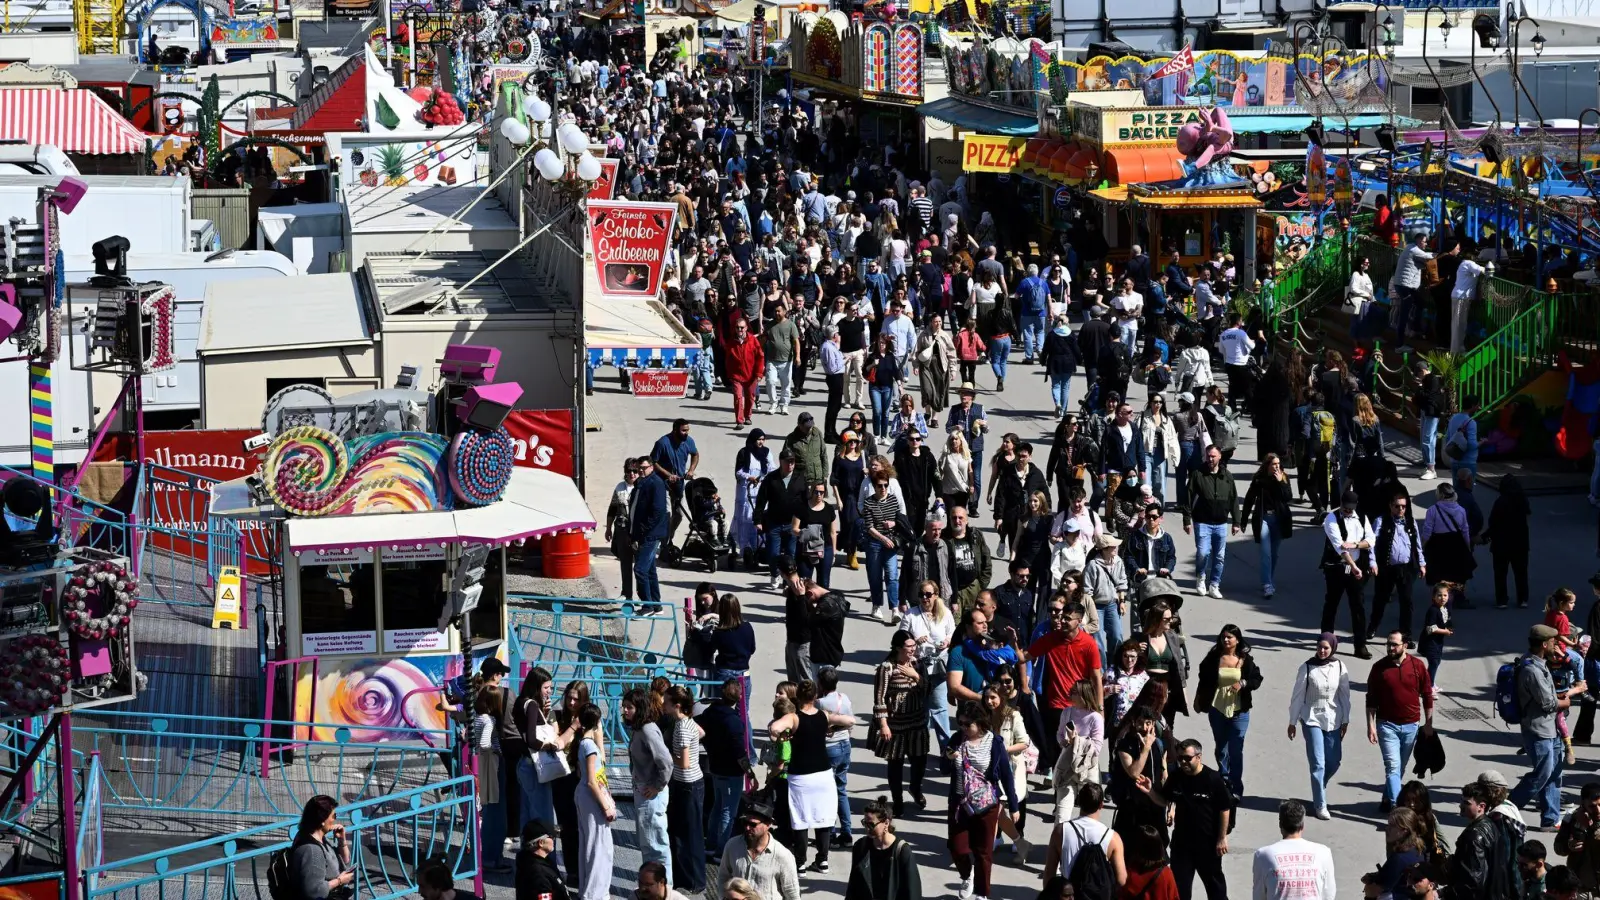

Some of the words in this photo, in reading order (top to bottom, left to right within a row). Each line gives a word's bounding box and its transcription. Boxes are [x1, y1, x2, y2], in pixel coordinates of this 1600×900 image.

[1163, 47, 1192, 75] KASSE
[1132, 112, 1201, 125] PIZZA
[1118, 126, 1178, 140] BÄCKE
[966, 142, 1021, 168] PIZZA
[611, 208, 648, 220] Feinste
[602, 218, 660, 240] Schoko-
[598, 237, 660, 262] Erdbeeren
[507, 434, 554, 467] n's
[1302, 854, 1312, 862] EX
